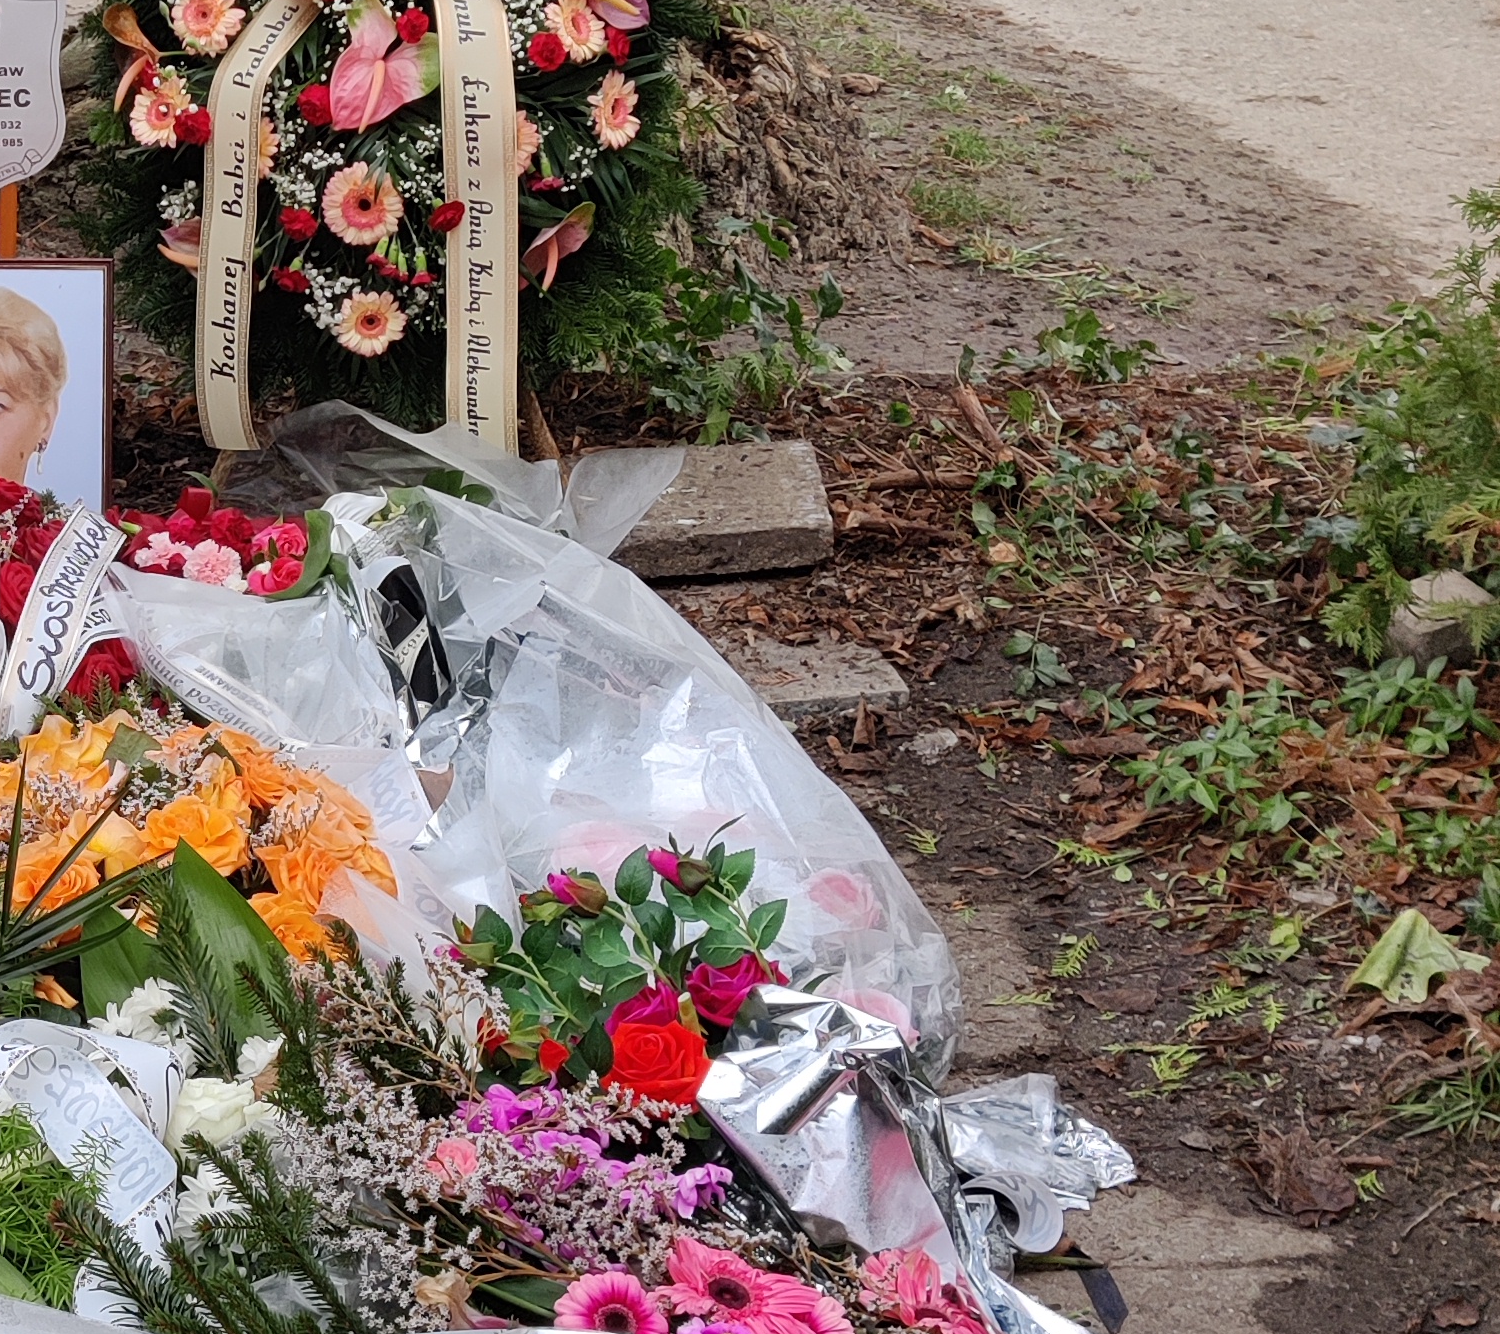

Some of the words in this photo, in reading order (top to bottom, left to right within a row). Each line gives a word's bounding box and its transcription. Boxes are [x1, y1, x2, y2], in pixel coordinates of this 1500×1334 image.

[232, 4, 300, 91] Prababci
[461, 74, 492, 169] Łukasz
[221, 138, 244, 219] Babci
[467, 177, 481, 192] z
[465, 199, 494, 249] Anią
[464, 257, 494, 313] Kubą
[210, 256, 246, 383] Kochanej
[467, 318, 485, 328] i
